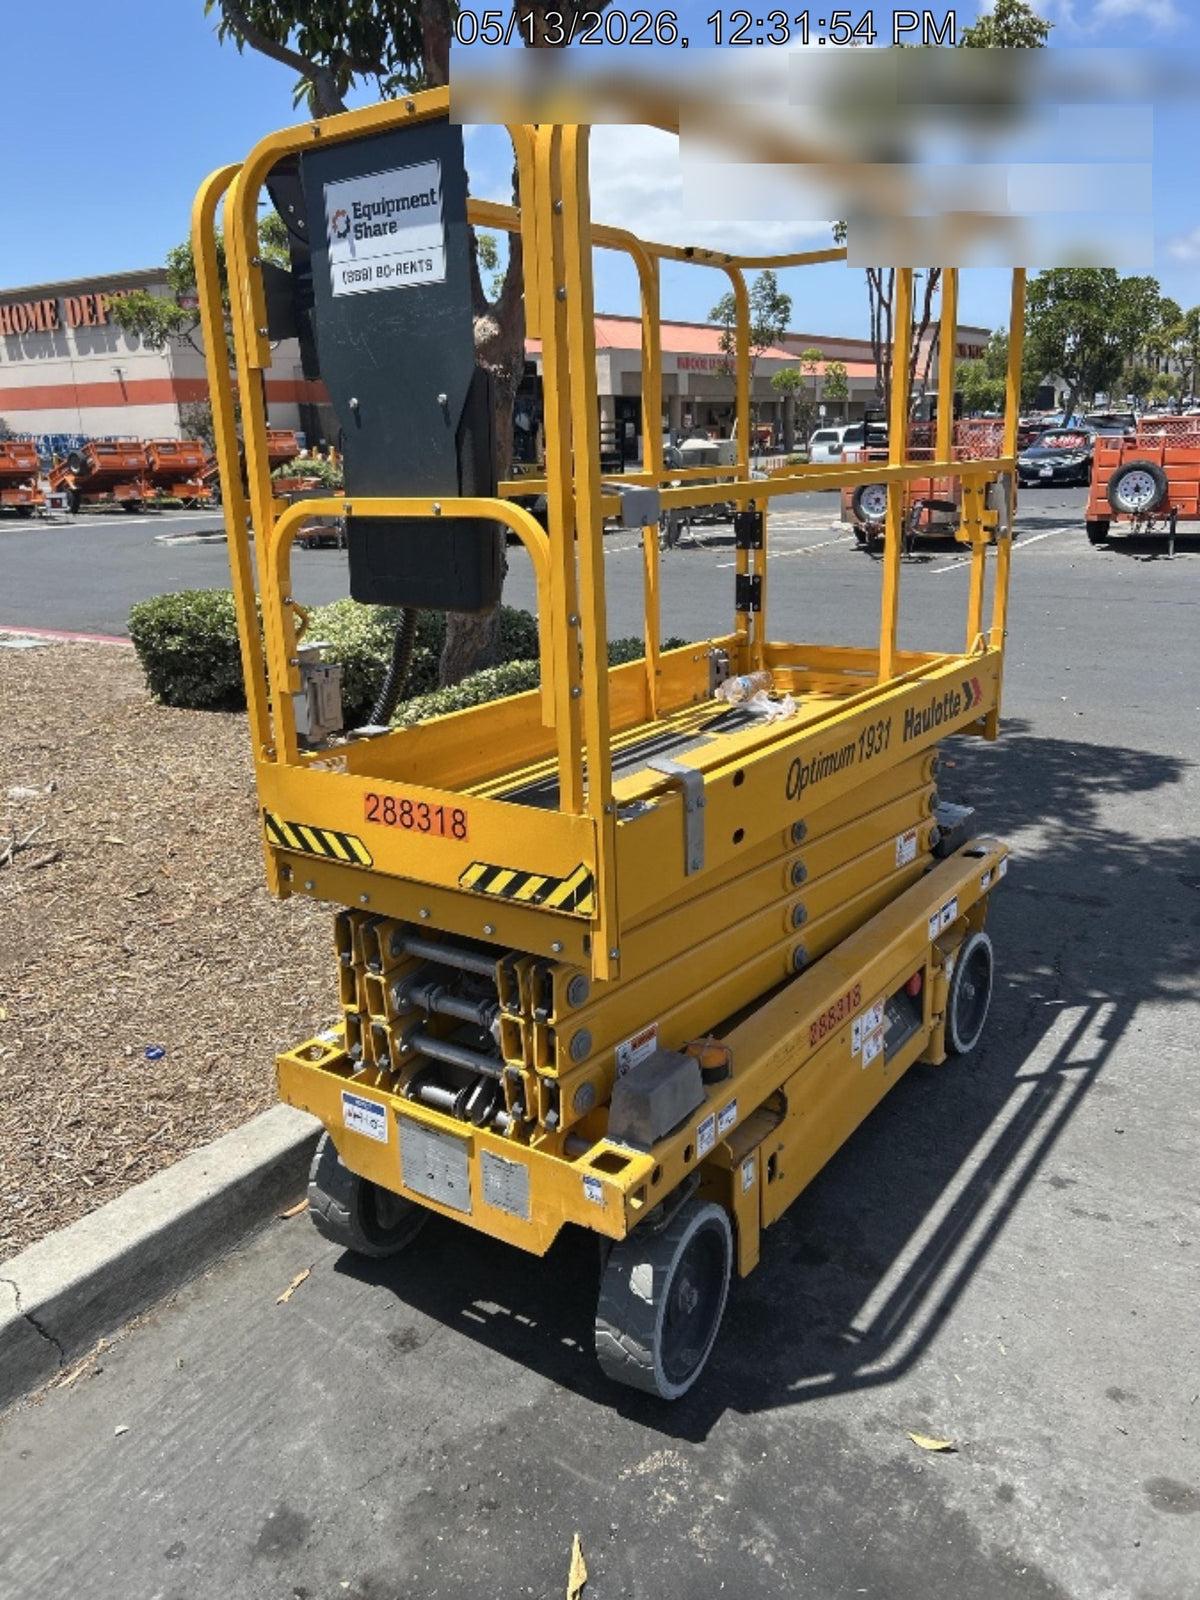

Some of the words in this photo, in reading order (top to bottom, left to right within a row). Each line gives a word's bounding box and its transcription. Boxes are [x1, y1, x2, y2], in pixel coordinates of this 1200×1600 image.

[351, 188, 438, 221] Equipment
[353, 221, 398, 241] Share
[0, 299, 60, 336] HOME
[64, 289, 145, 328] DEP
[785, 742, 856, 800] Optimum
[858, 717, 892, 763] 1931
[903, 688, 961, 743] Haulotte
[365, 793, 467, 840] 288318
[810, 983, 861, 1048] 288318
